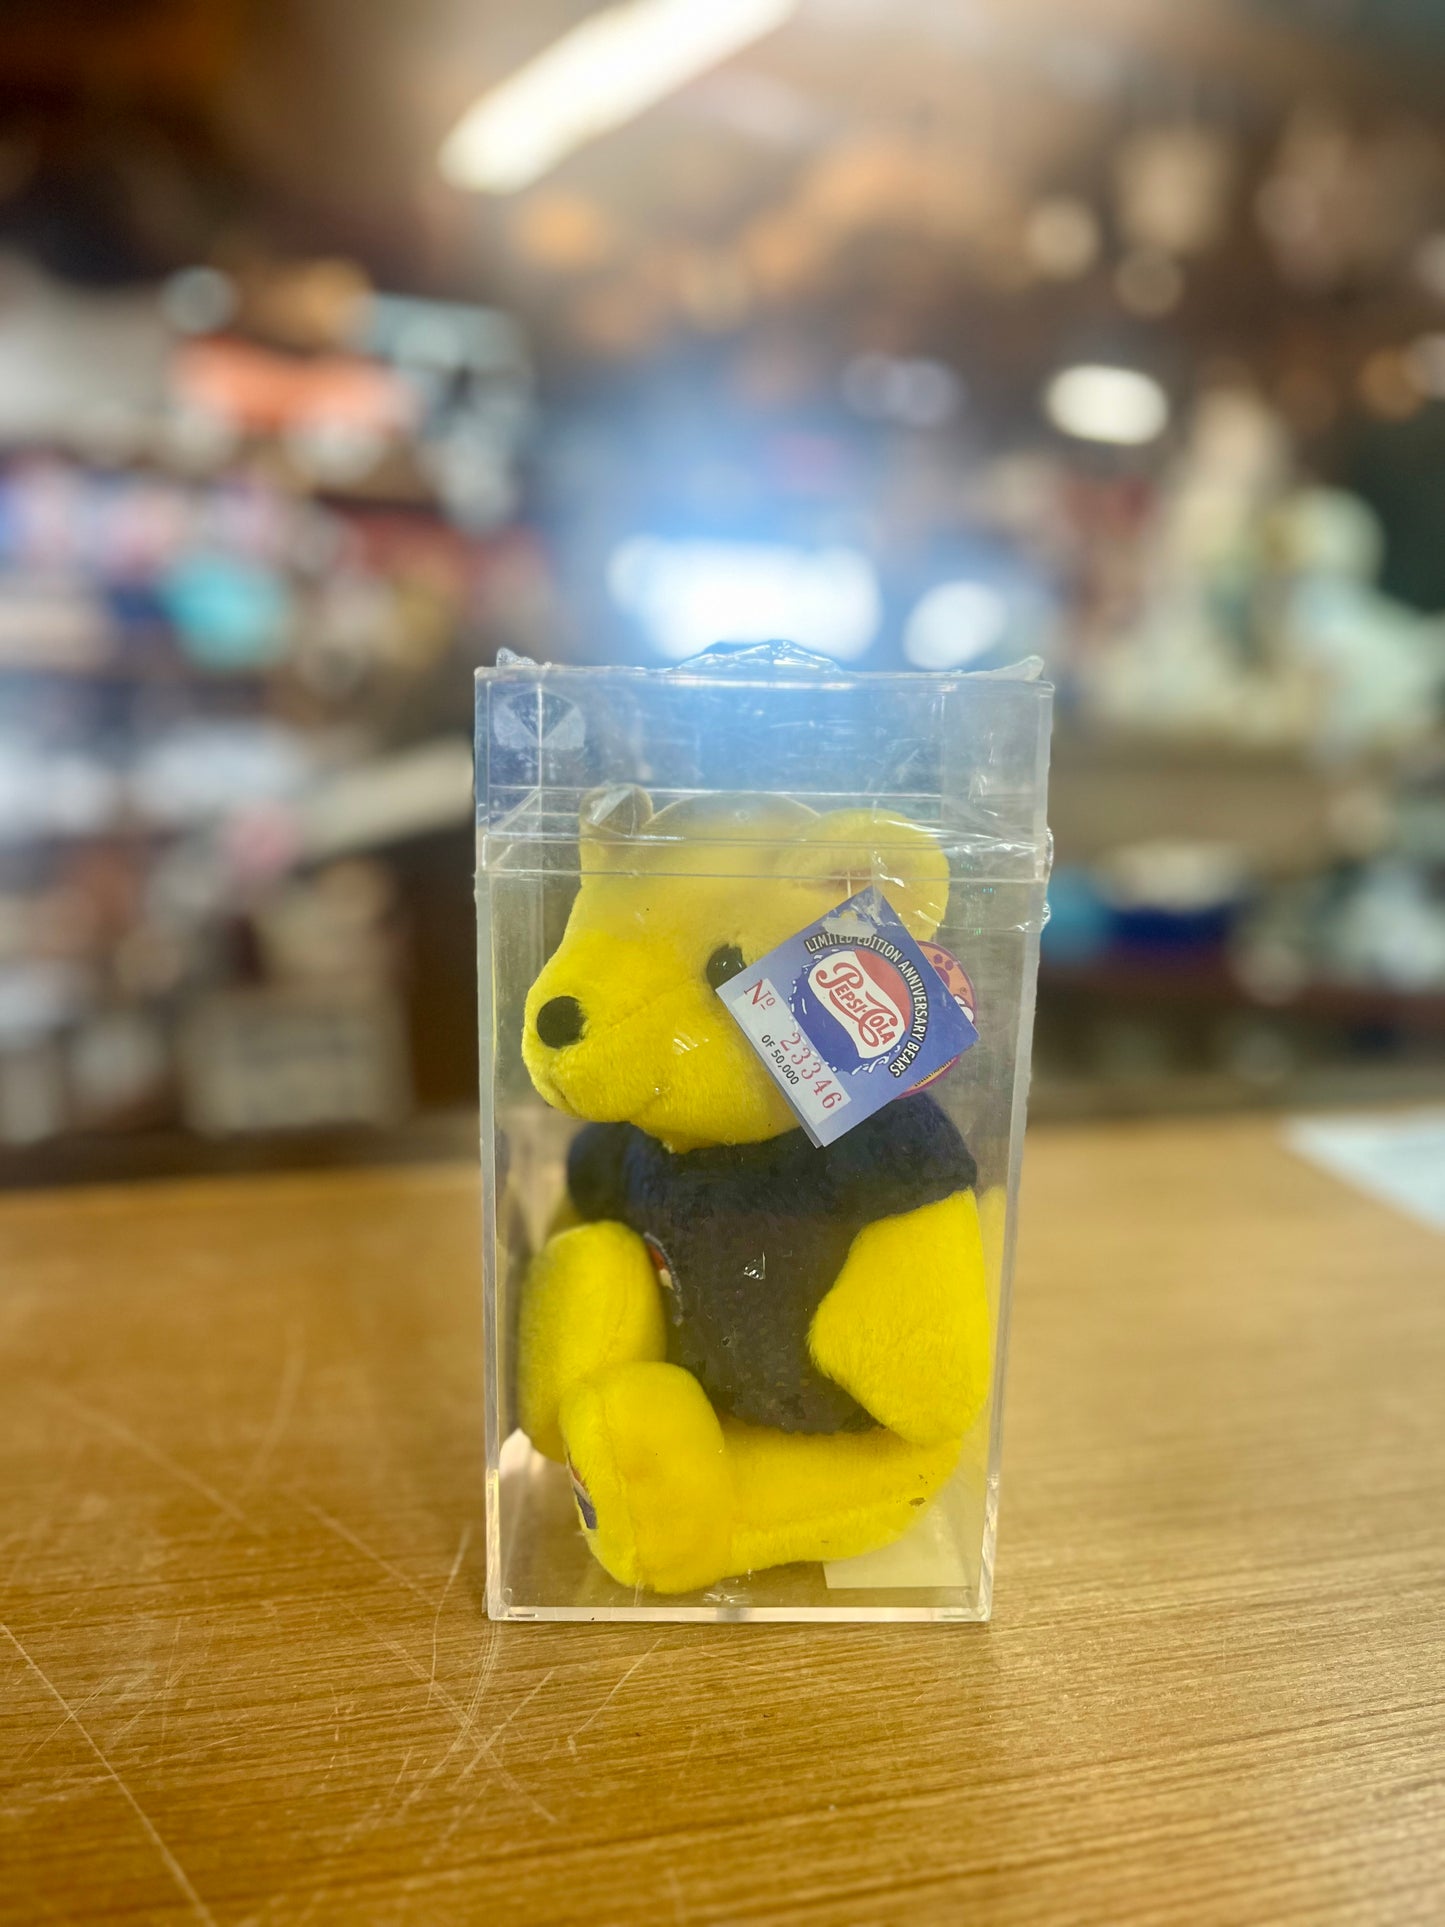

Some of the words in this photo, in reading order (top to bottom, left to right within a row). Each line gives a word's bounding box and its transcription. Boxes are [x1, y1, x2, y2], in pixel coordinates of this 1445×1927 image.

[898, 960, 928, 1042] ANNIVERSARY
[761, 1034, 776, 1048] OF
[770, 1048, 800, 1085] 50,000
[780, 1032, 842, 1109] 23346
[890, 1041, 920, 1077] BEARS
